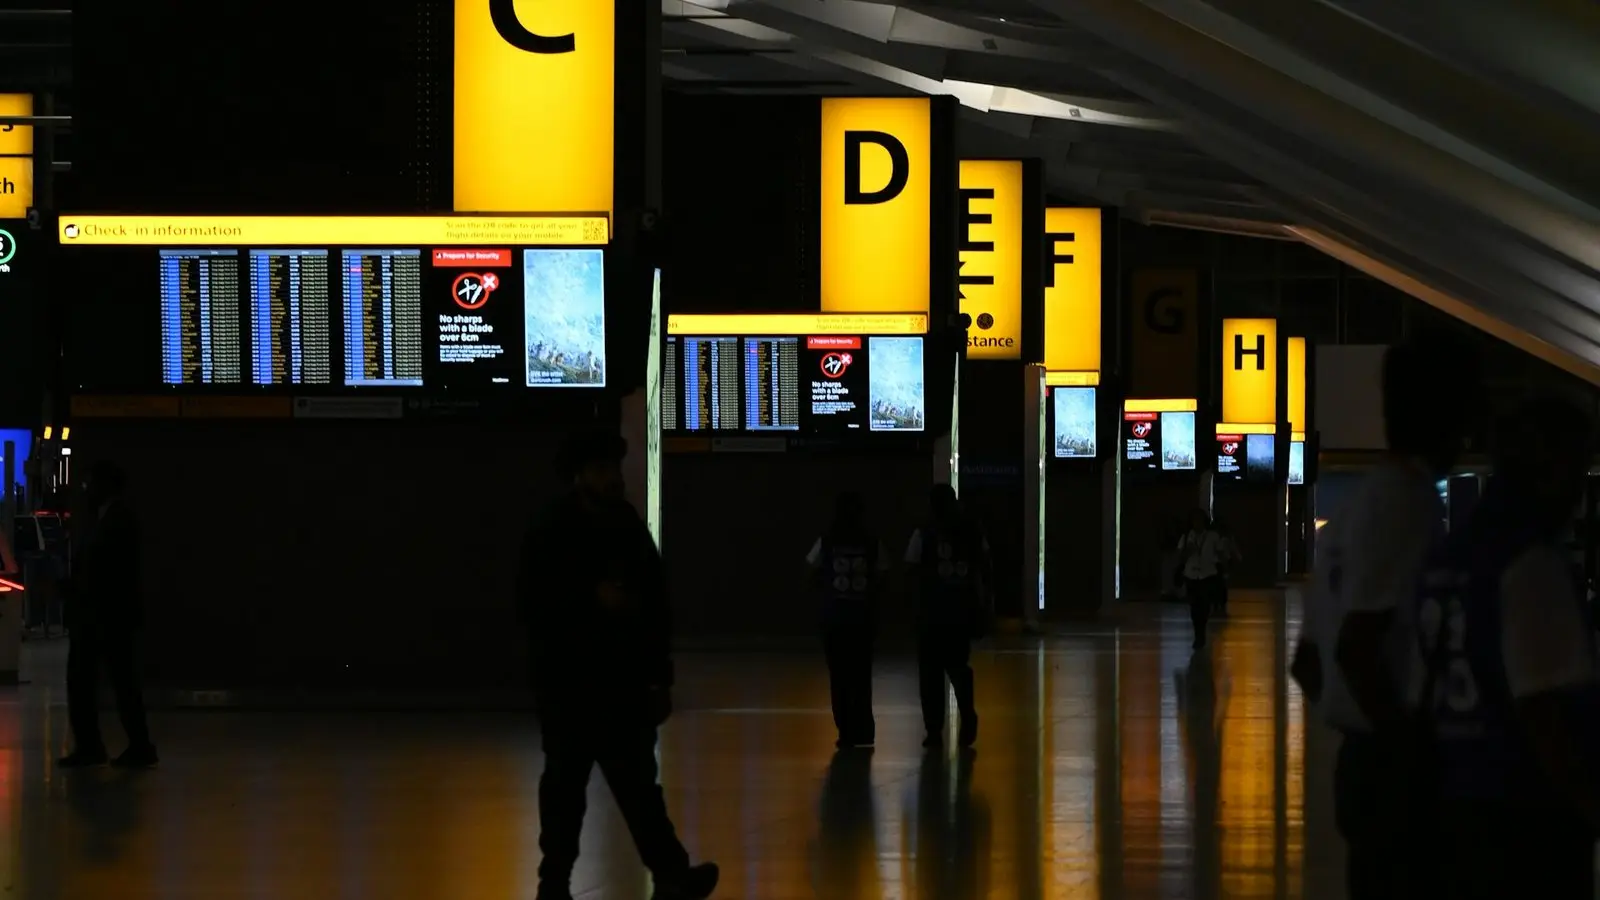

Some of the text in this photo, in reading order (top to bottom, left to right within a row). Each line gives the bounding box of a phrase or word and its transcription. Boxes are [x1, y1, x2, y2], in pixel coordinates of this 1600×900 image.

[844, 130, 909, 205] D
[84, 224, 242, 237] Check-in information
[958, 188, 995, 252] E
[1044, 232, 1075, 288] F
[440, 315, 482, 325] No sharps
[1144, 285, 1185, 335] G
[440, 324, 493, 333] with a blade
[440, 333, 480, 342] over 6cm
[967, 334, 1015, 349] stance
[1234, 334, 1265, 371] H
